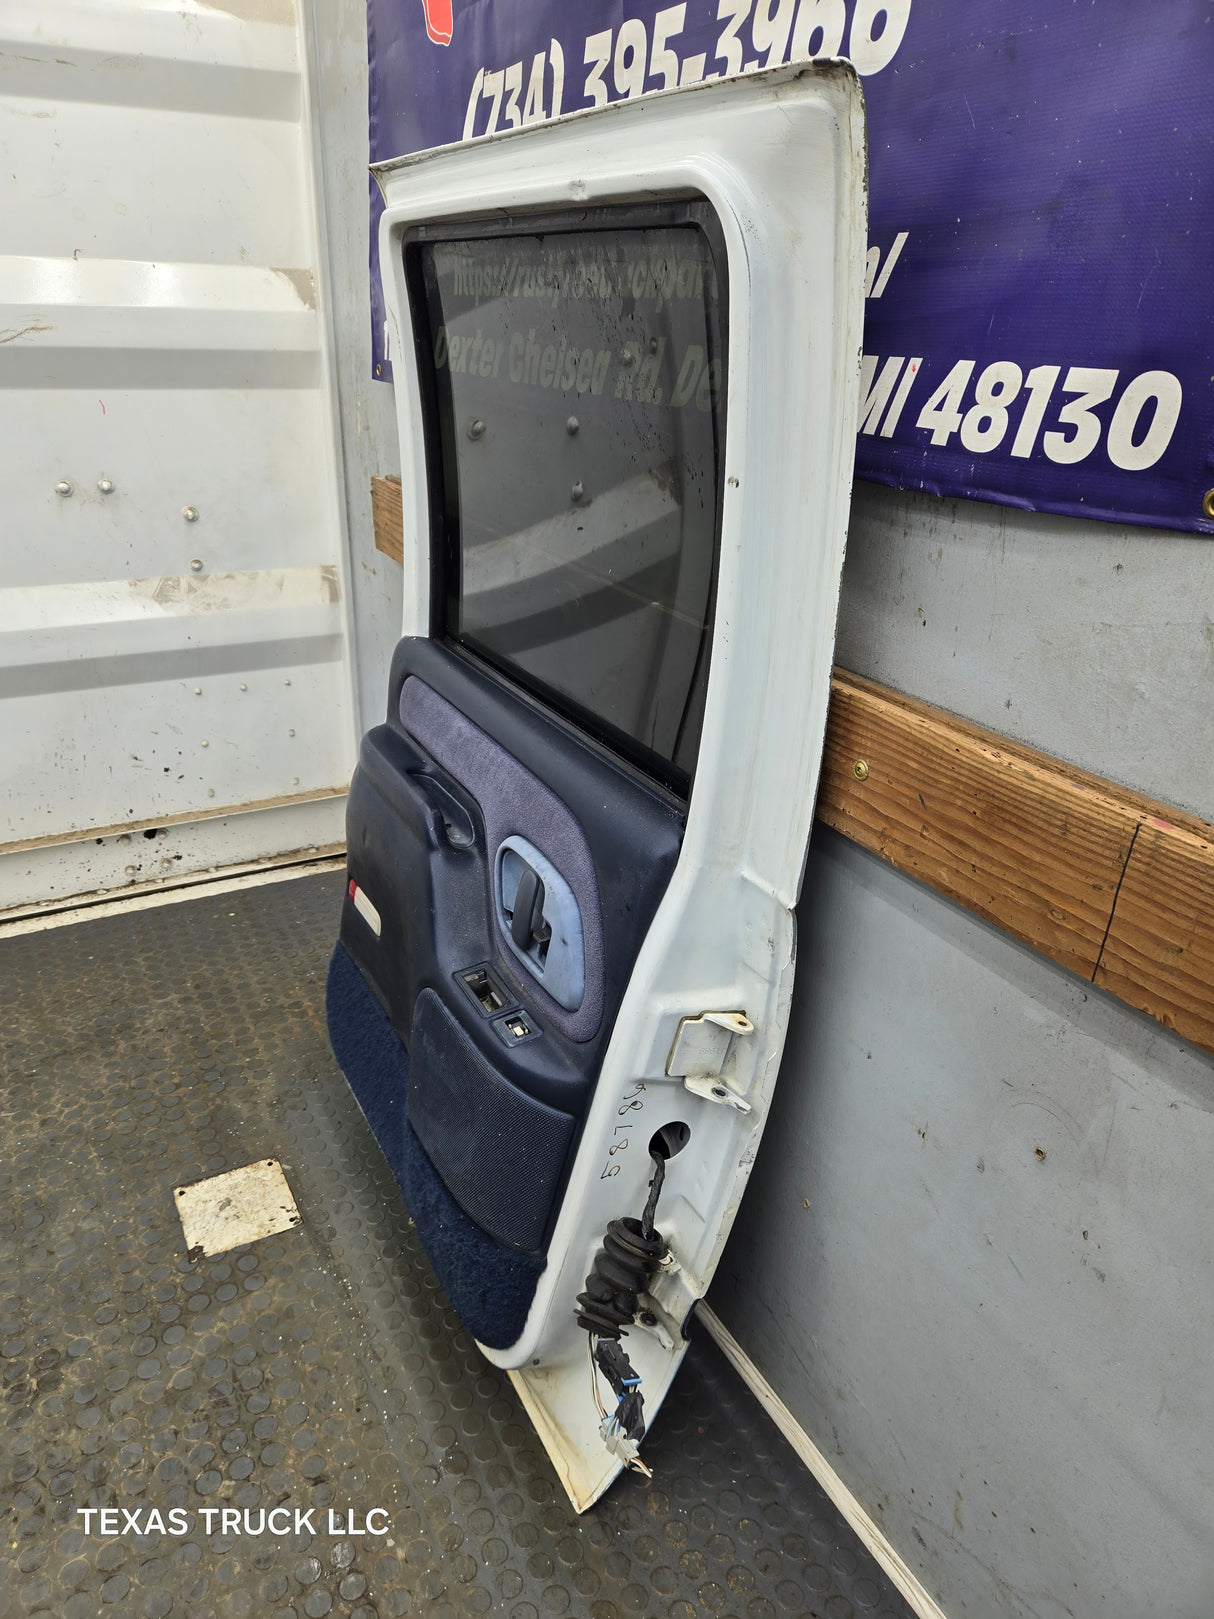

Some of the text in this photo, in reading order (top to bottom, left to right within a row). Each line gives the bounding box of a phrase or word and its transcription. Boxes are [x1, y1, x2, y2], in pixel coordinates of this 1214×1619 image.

[462, 38, 565, 140] (734)
[434, 325, 500, 377] Dexter
[509, 328, 612, 396] Chelsea
[915, 359, 1183, 471] 48130
